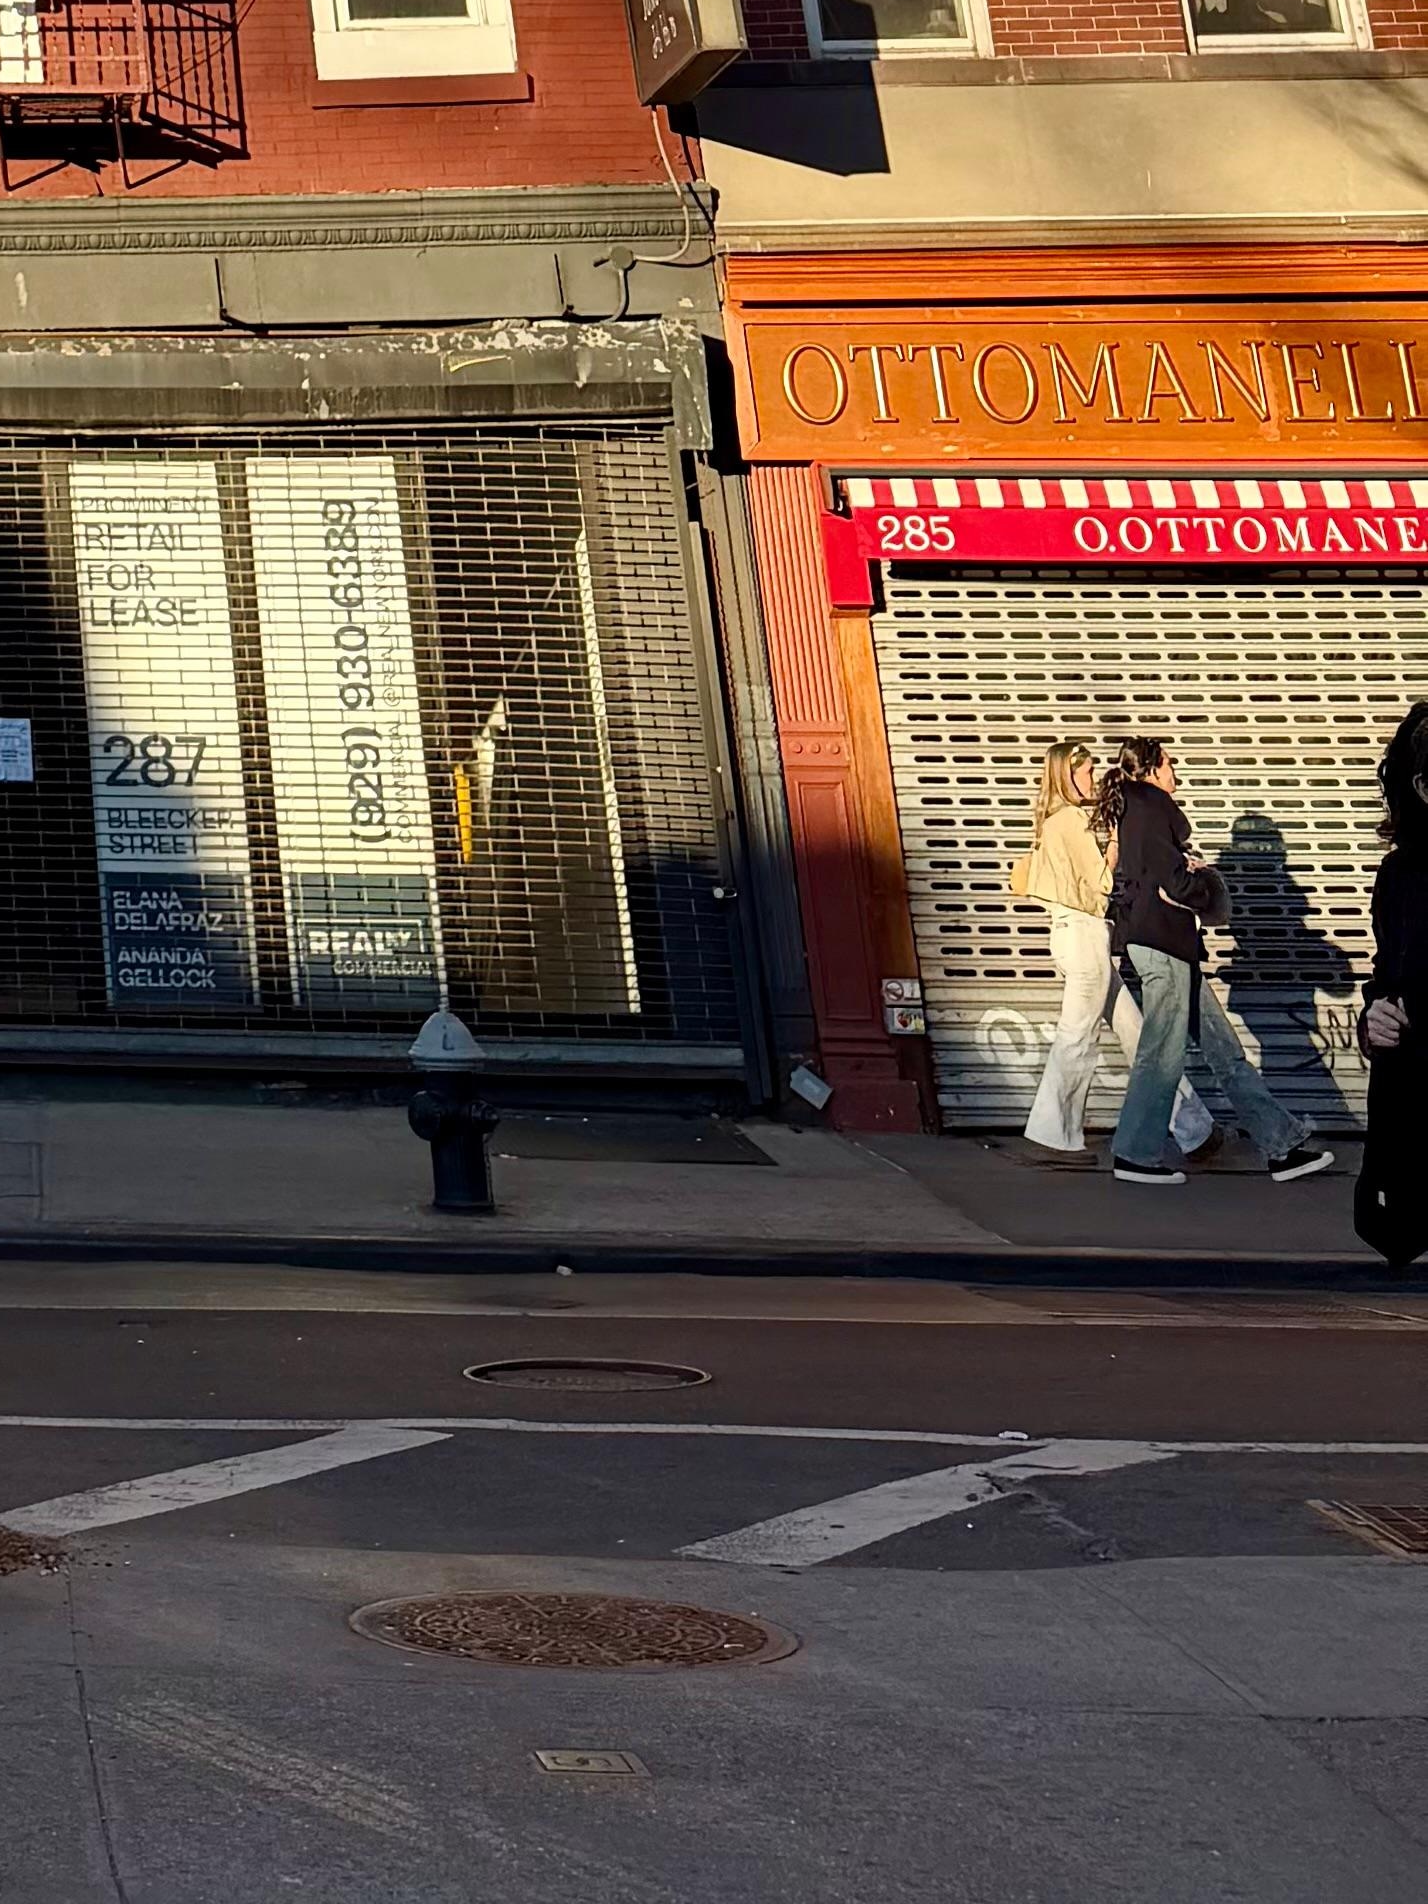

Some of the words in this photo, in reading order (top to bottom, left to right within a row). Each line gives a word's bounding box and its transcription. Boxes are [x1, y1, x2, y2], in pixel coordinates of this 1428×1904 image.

[85, 523, 199, 551] RETAIL
[877, 514, 957, 553] 285
[87, 563, 156, 591] FOR
[90, 598, 200, 627] LEASE
[322, 498, 375, 710] 930-6389
[102, 734, 208, 789] 287
[106, 807, 234, 829] BLEECKER
[109, 833, 200, 855] STREET
[112, 890, 184, 910] ELANA
[118, 967, 217, 989] GELLOCK
